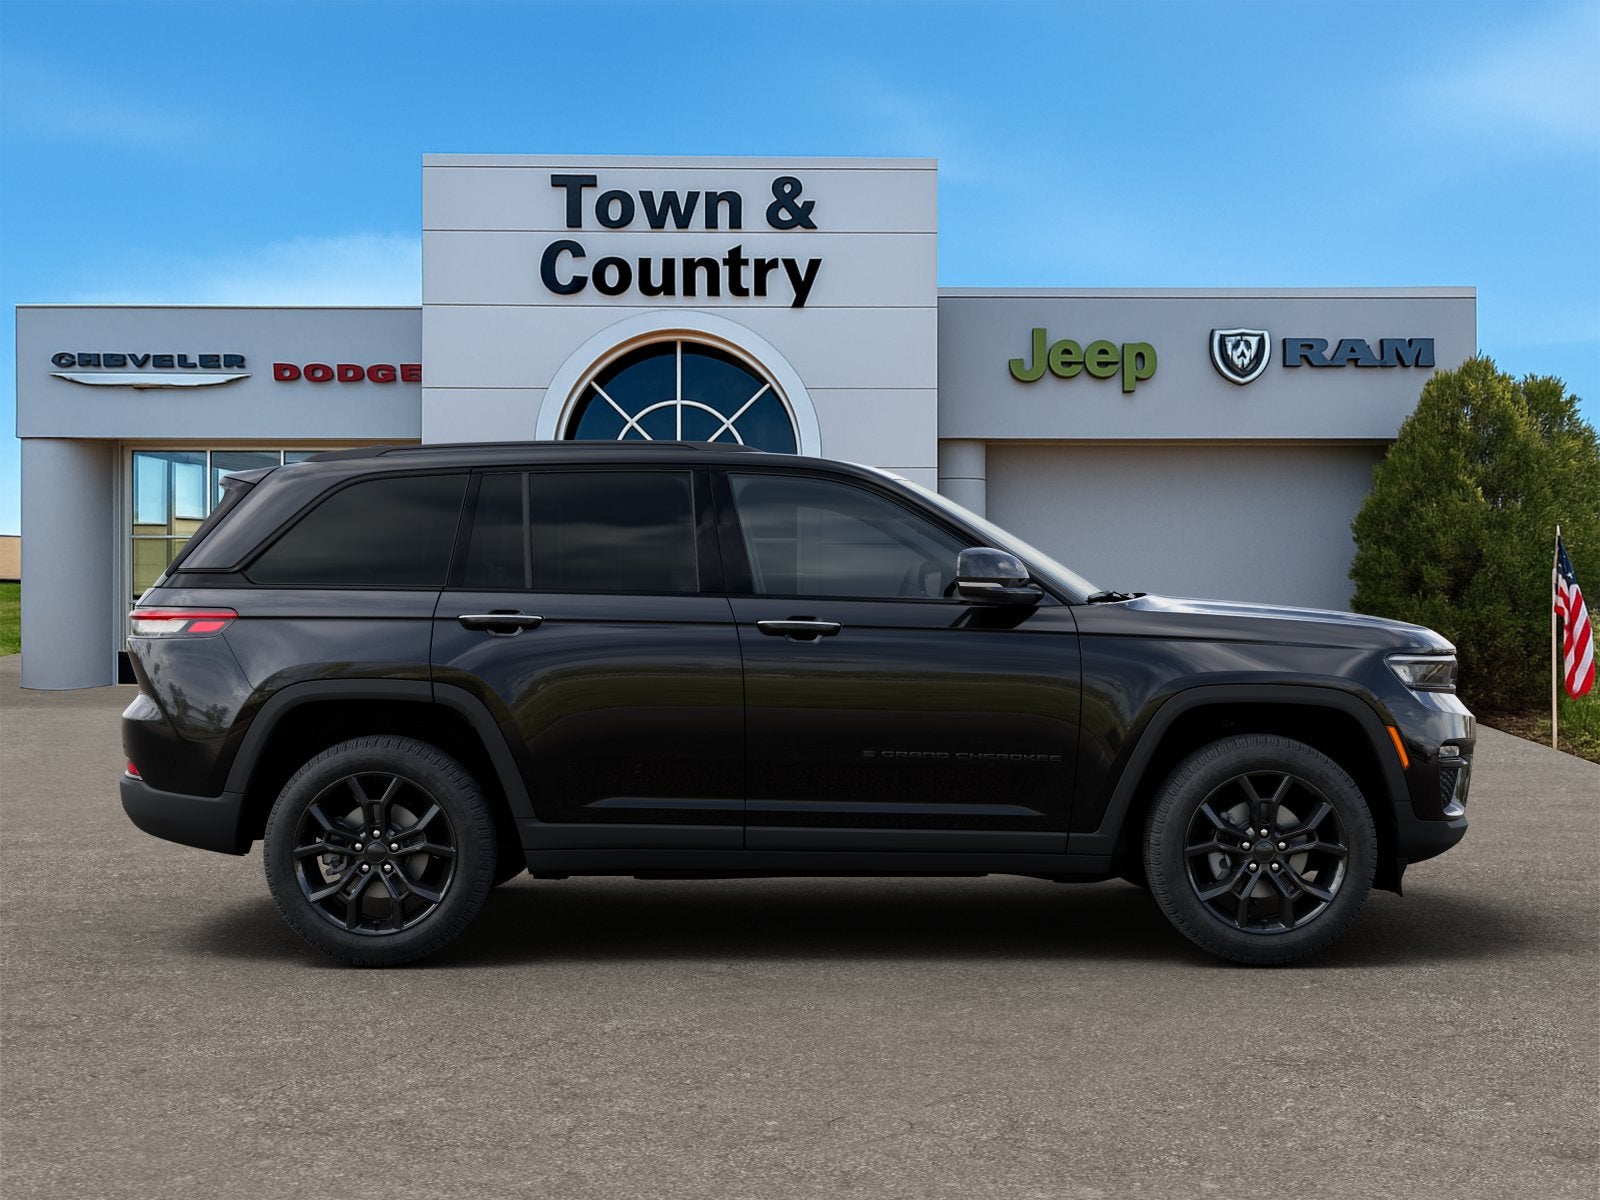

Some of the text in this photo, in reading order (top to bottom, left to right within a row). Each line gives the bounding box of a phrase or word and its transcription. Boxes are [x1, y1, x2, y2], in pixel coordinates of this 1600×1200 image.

[550, 174, 818, 230] Town &
[540, 239, 823, 308] Country
[272, 362, 422, 383] DODGE
[1009, 328, 1158, 392] Jeep
[1283, 337, 1435, 368] RAM
[881, 750, 1063, 762] GRAND CHEROKEE
